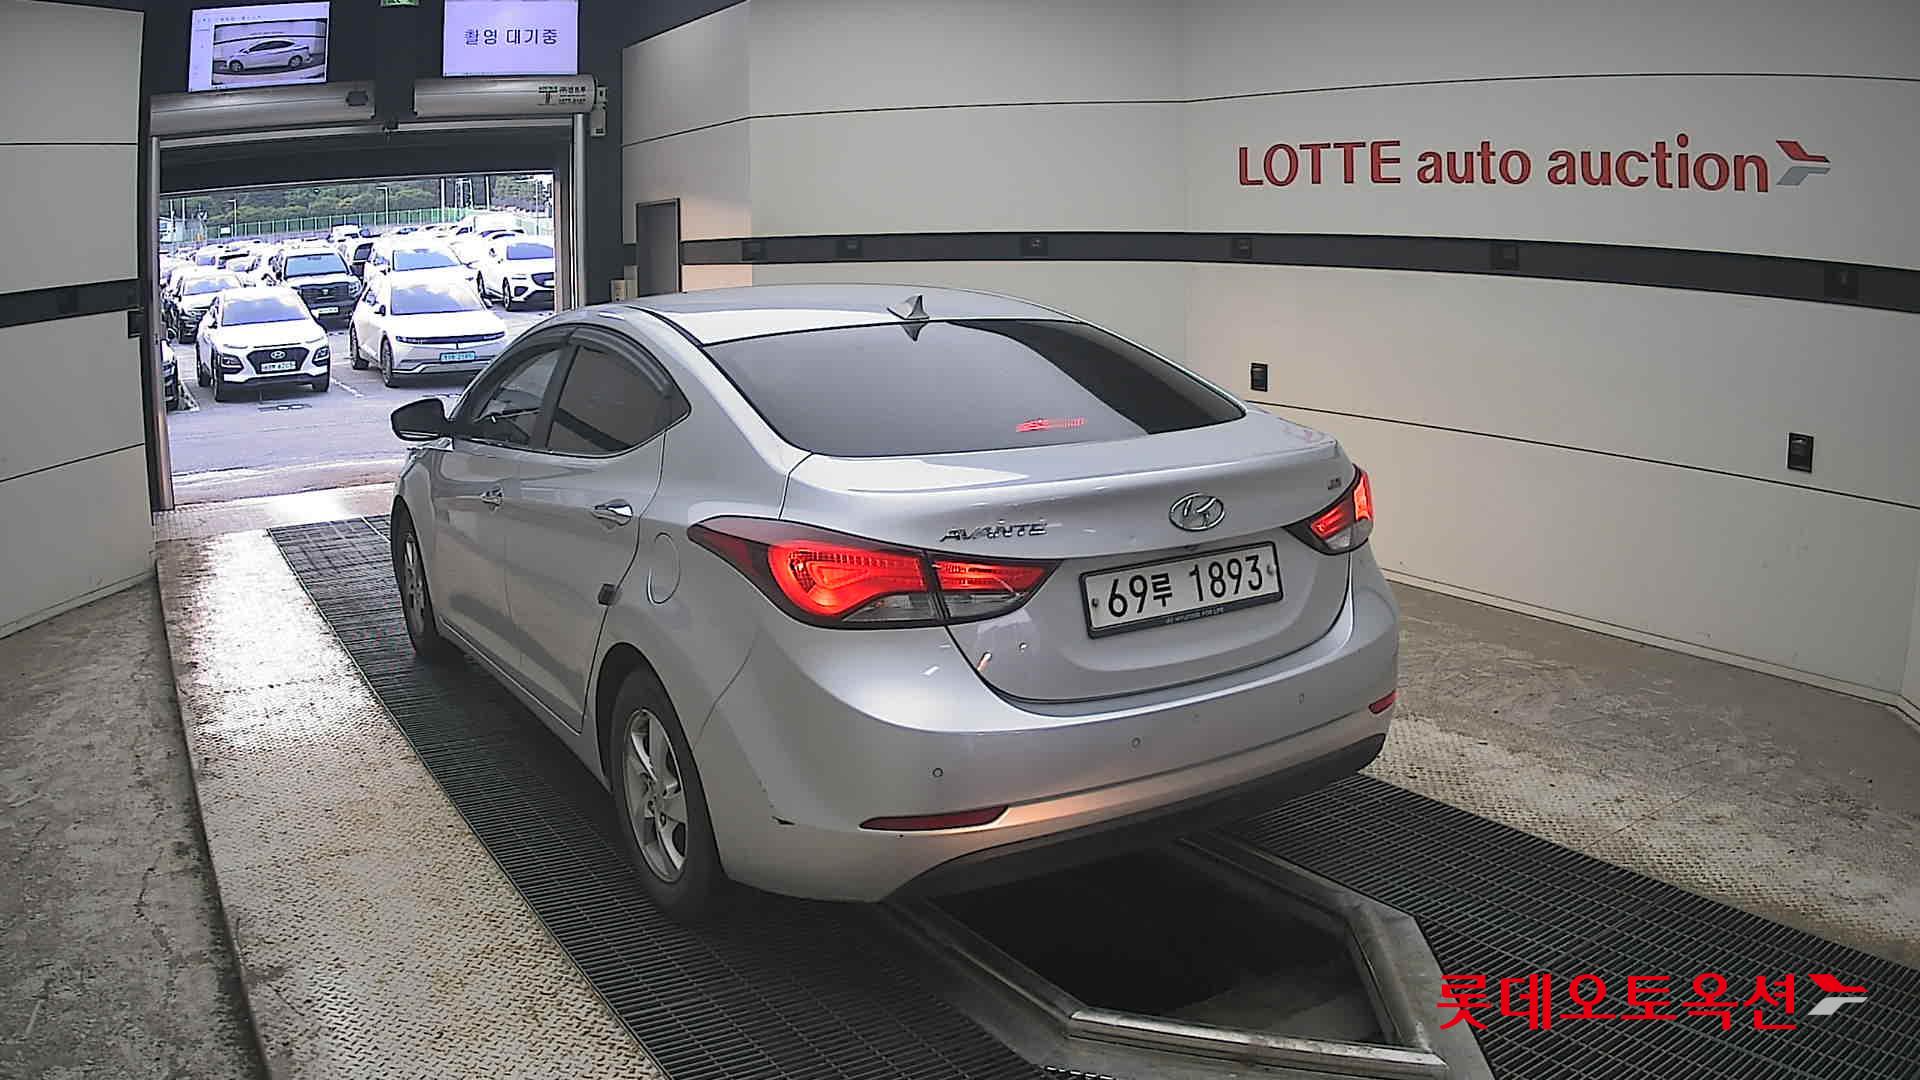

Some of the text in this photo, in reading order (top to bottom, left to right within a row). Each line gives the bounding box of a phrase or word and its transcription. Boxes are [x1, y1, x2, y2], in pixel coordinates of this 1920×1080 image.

[506, 28, 558, 45] 대기중
[1238, 133, 1769, 192] LOTTE auto auction
[939, 522, 1048, 542] AVANTE
[1107, 554, 1264, 618] 69루 1893
